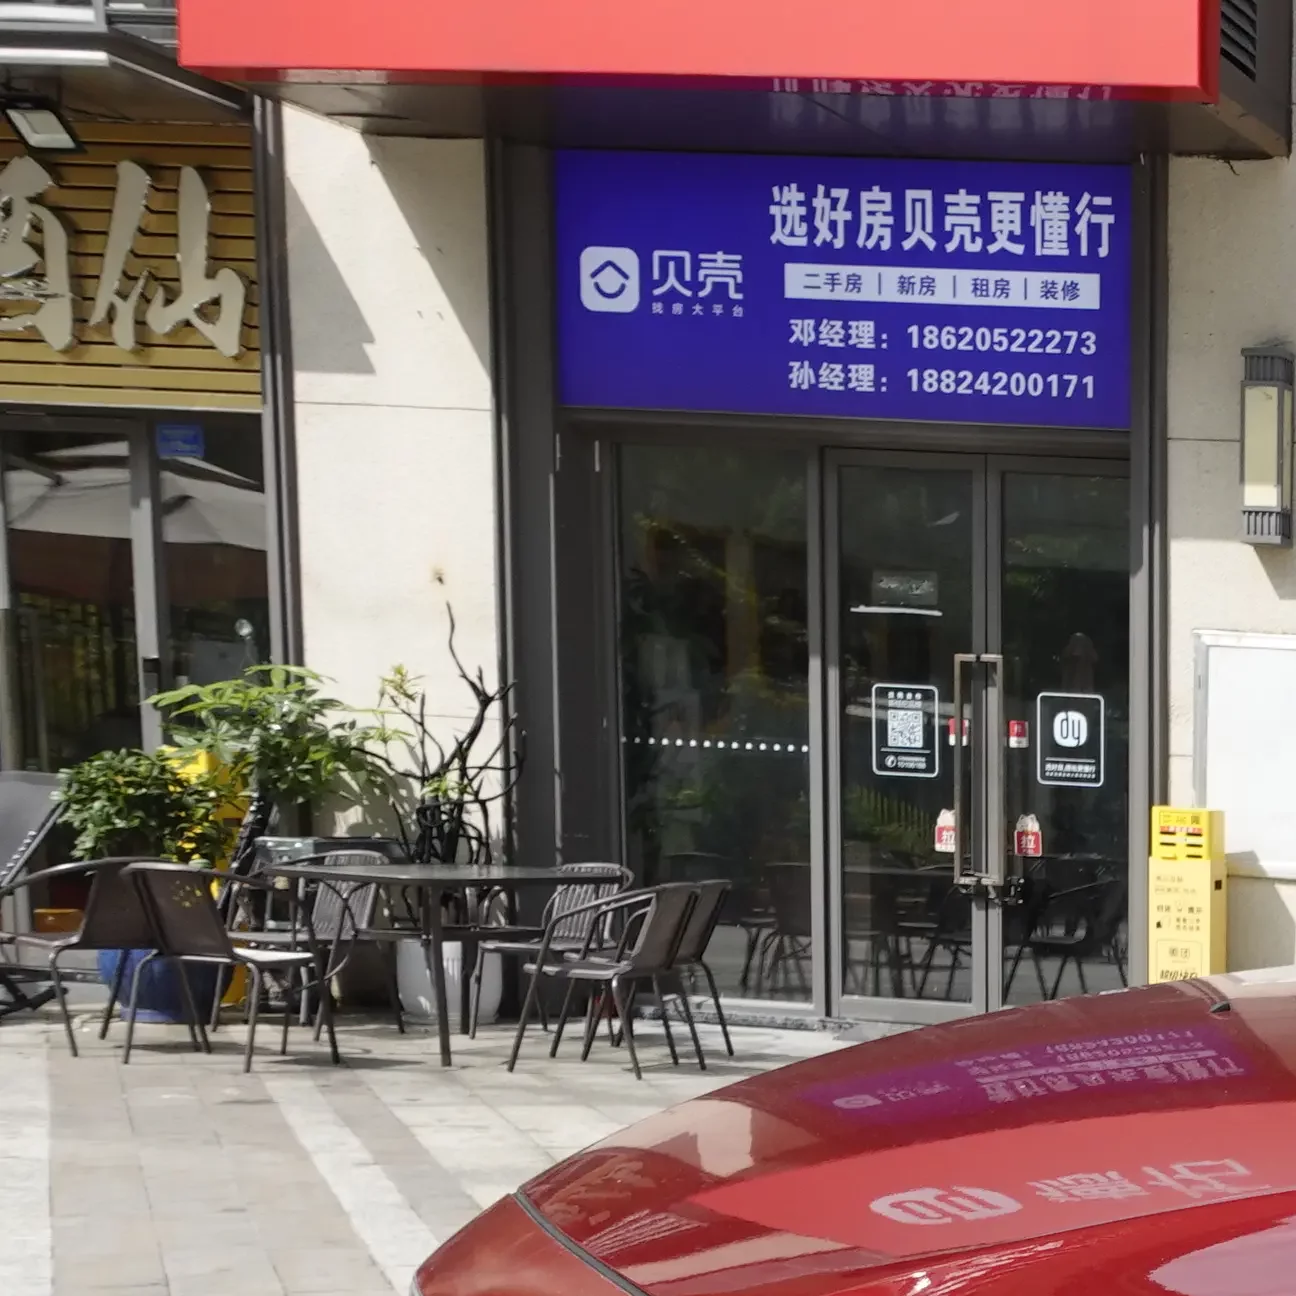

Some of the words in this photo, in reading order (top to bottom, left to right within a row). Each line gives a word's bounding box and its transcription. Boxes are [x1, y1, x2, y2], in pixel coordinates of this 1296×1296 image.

[769, 183, 1115, 258] 选好房贝壳更懂行
[651, 250, 743, 300] 贝壳
[802, 272, 863, 294] 二手房
[896, 274, 937, 297] 新房
[971, 277, 1010, 299] 租房
[1040, 279, 1081, 301] 装修
[651, 301, 744, 318] 找房大平台
[907, 324, 1097, 355] 18620522273
[907, 368, 1094, 399] 18824200171
